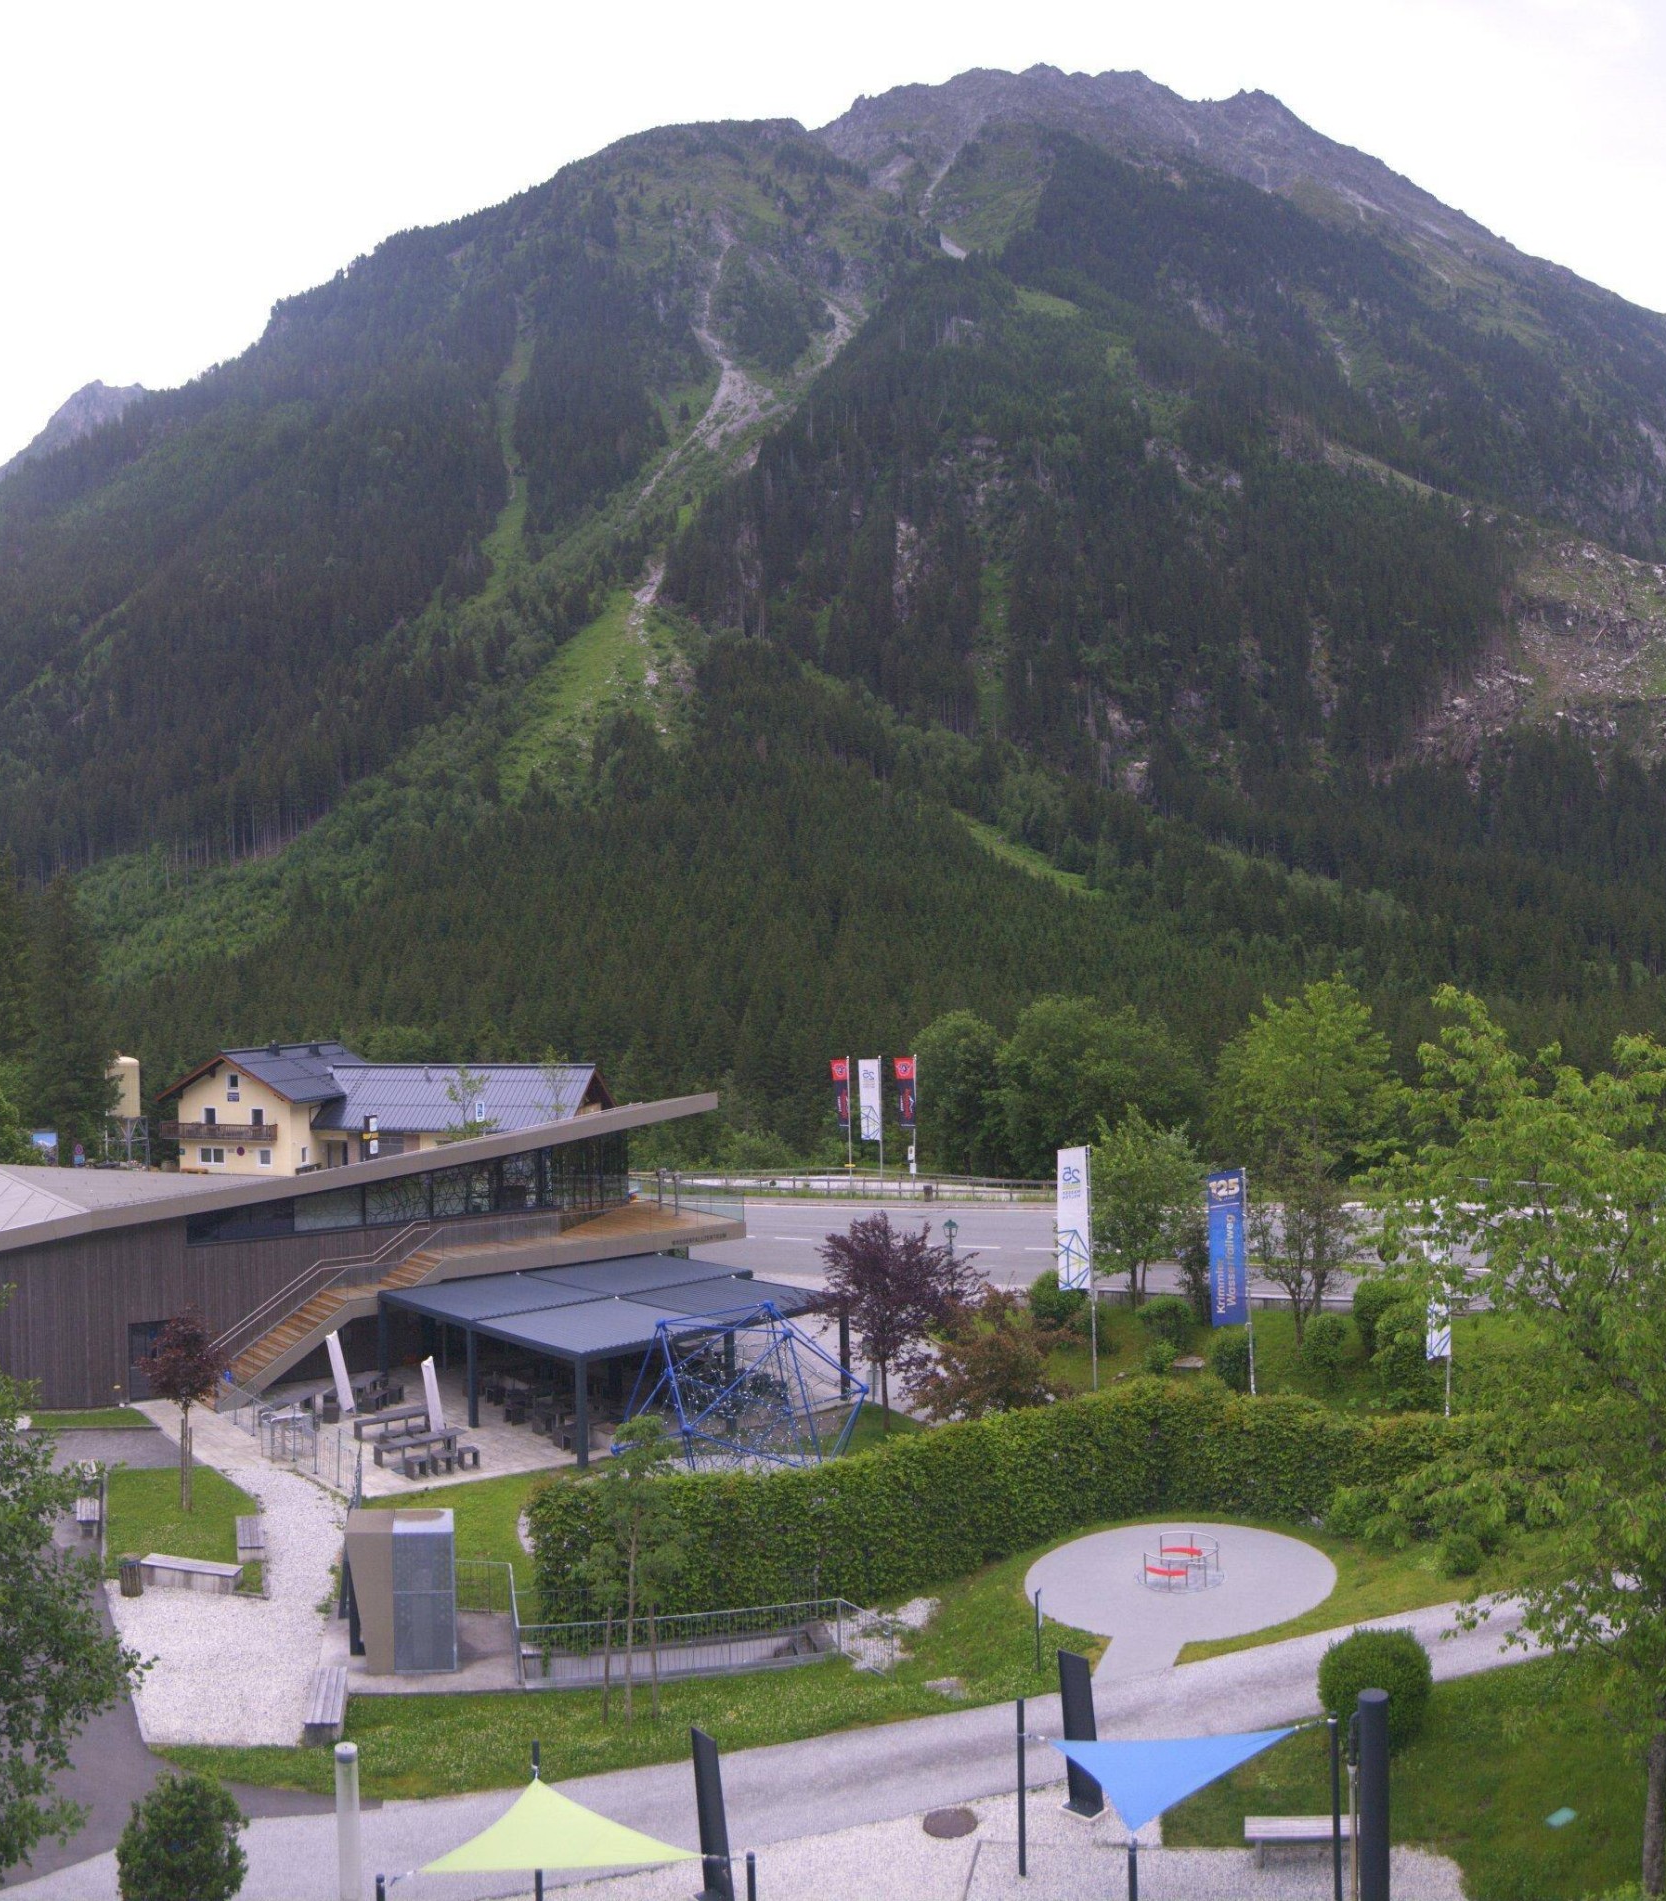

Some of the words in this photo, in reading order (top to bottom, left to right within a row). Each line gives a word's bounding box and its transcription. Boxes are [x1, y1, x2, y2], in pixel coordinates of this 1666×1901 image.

[1209, 1178, 1240, 1197] 125
[1216, 1259, 1226, 1314] Krimmler
[1225, 1214, 1237, 1306] Wasserfallweg
